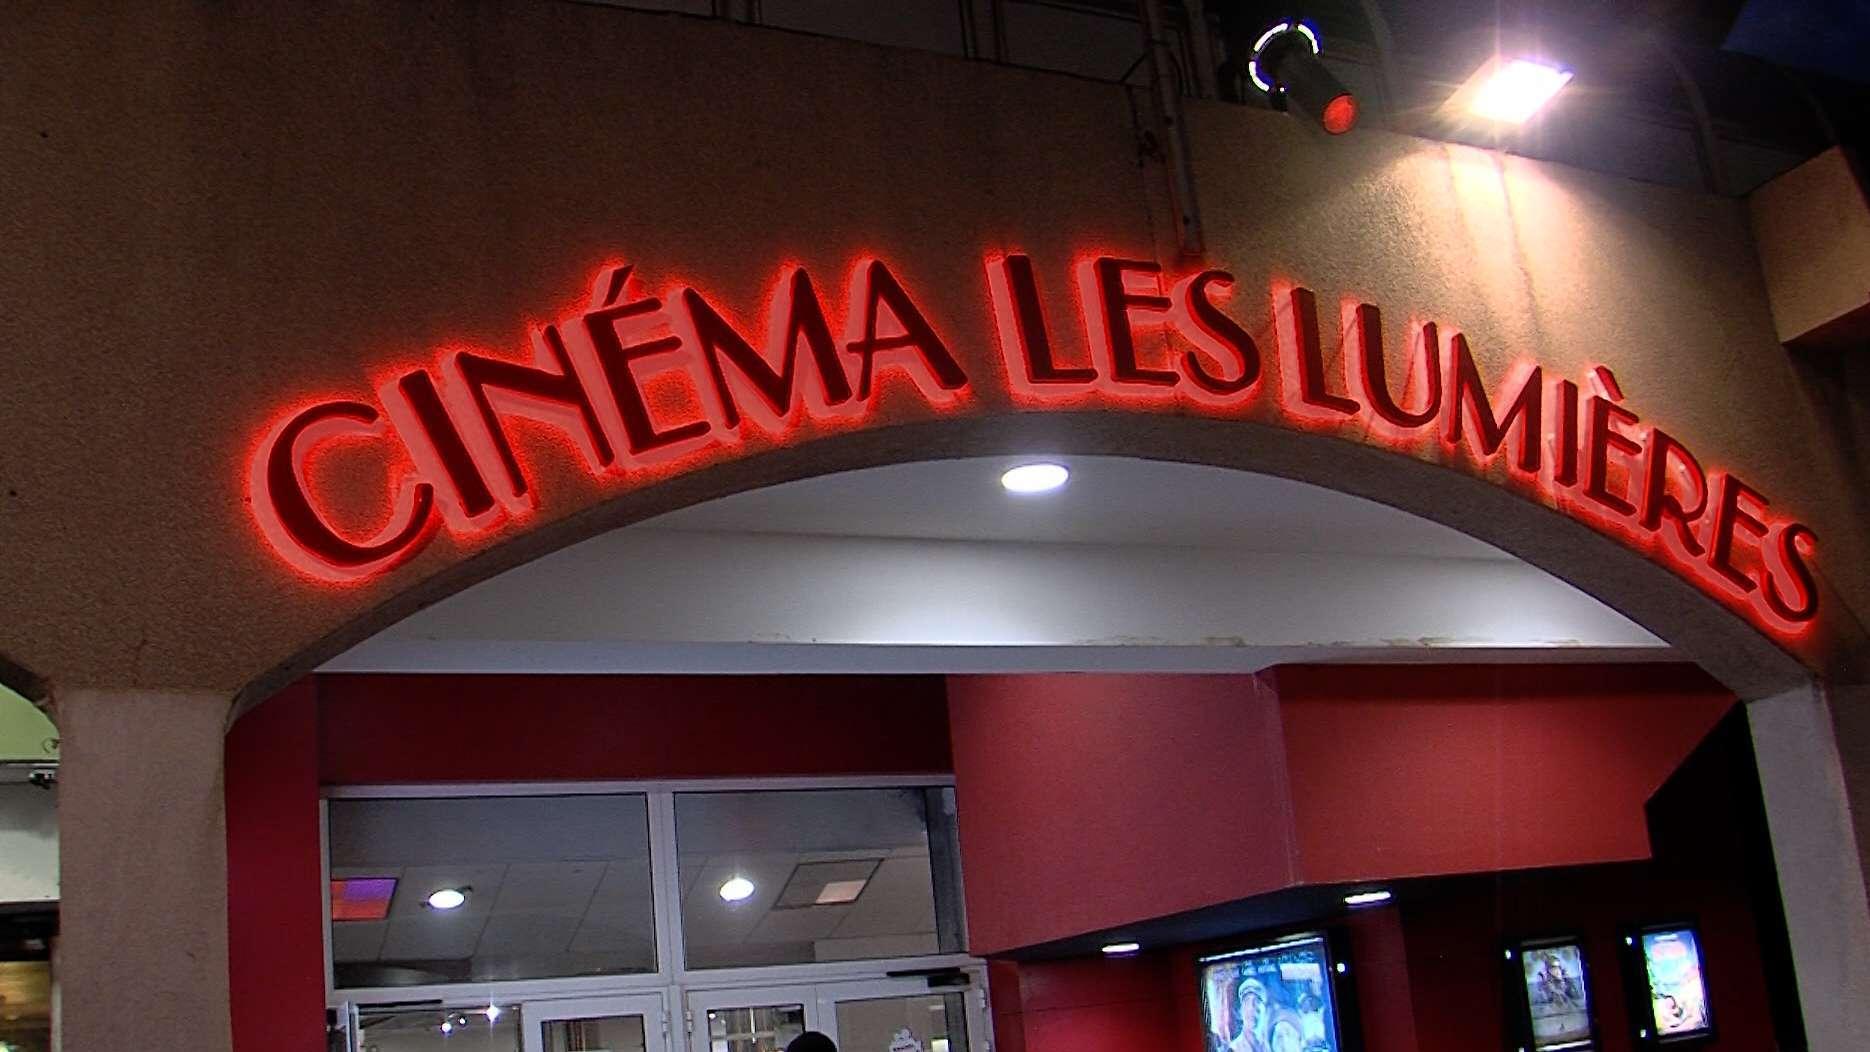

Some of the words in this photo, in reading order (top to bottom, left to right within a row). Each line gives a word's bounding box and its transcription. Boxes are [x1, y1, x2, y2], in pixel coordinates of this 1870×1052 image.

[264, 260, 968, 568] CINÉMA
[1000, 253, 1260, 397] LES
[1286, 285, 1821, 623] LUMIÈRES
